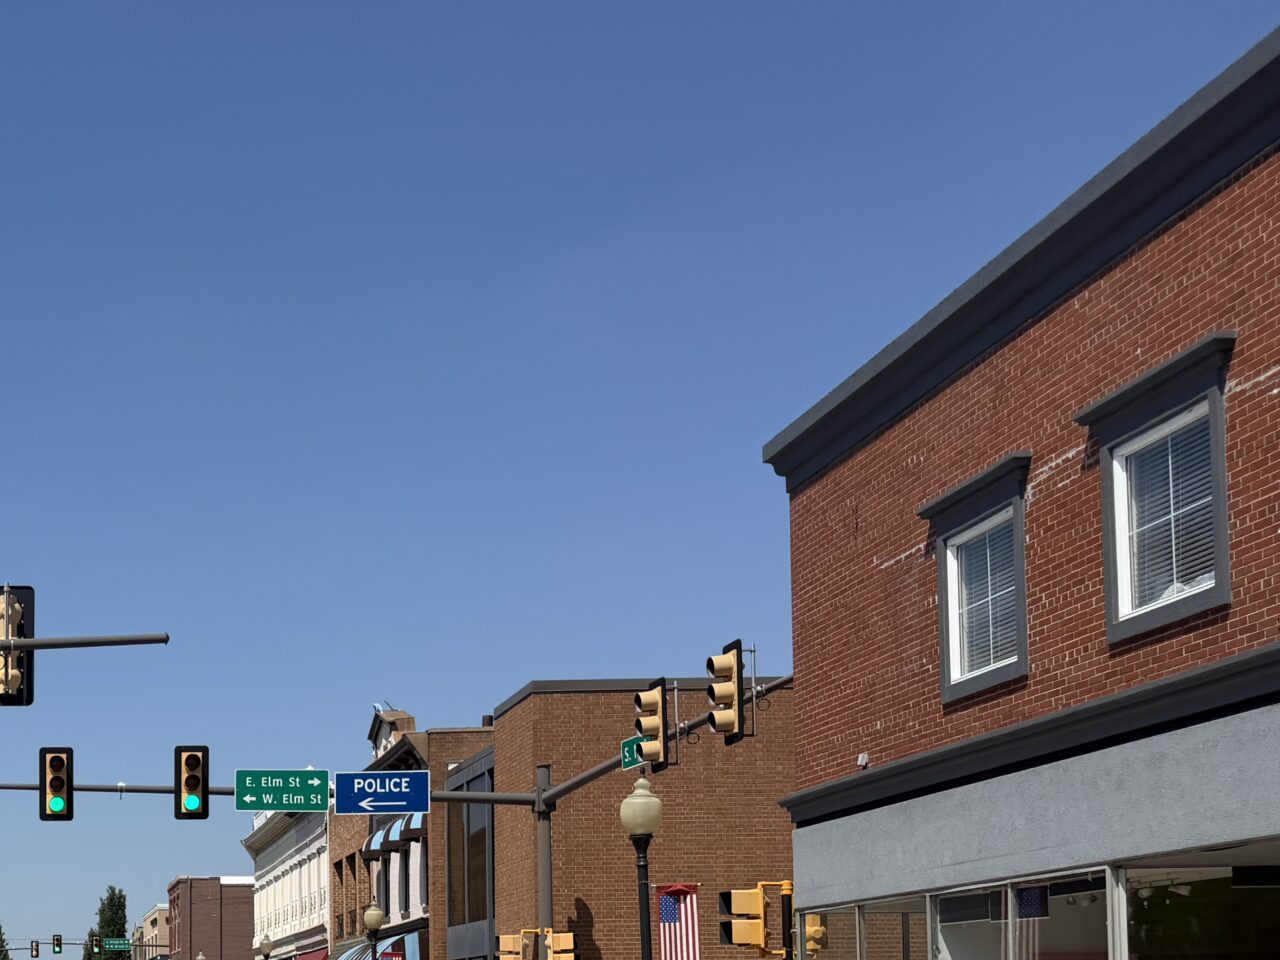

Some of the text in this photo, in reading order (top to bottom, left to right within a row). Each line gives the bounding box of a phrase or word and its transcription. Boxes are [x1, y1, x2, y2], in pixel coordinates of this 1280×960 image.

[245, 776, 301, 787] E. Elm St
[354, 778, 410, 792] POLICE
[262, 793, 322, 804] W. Elm St
